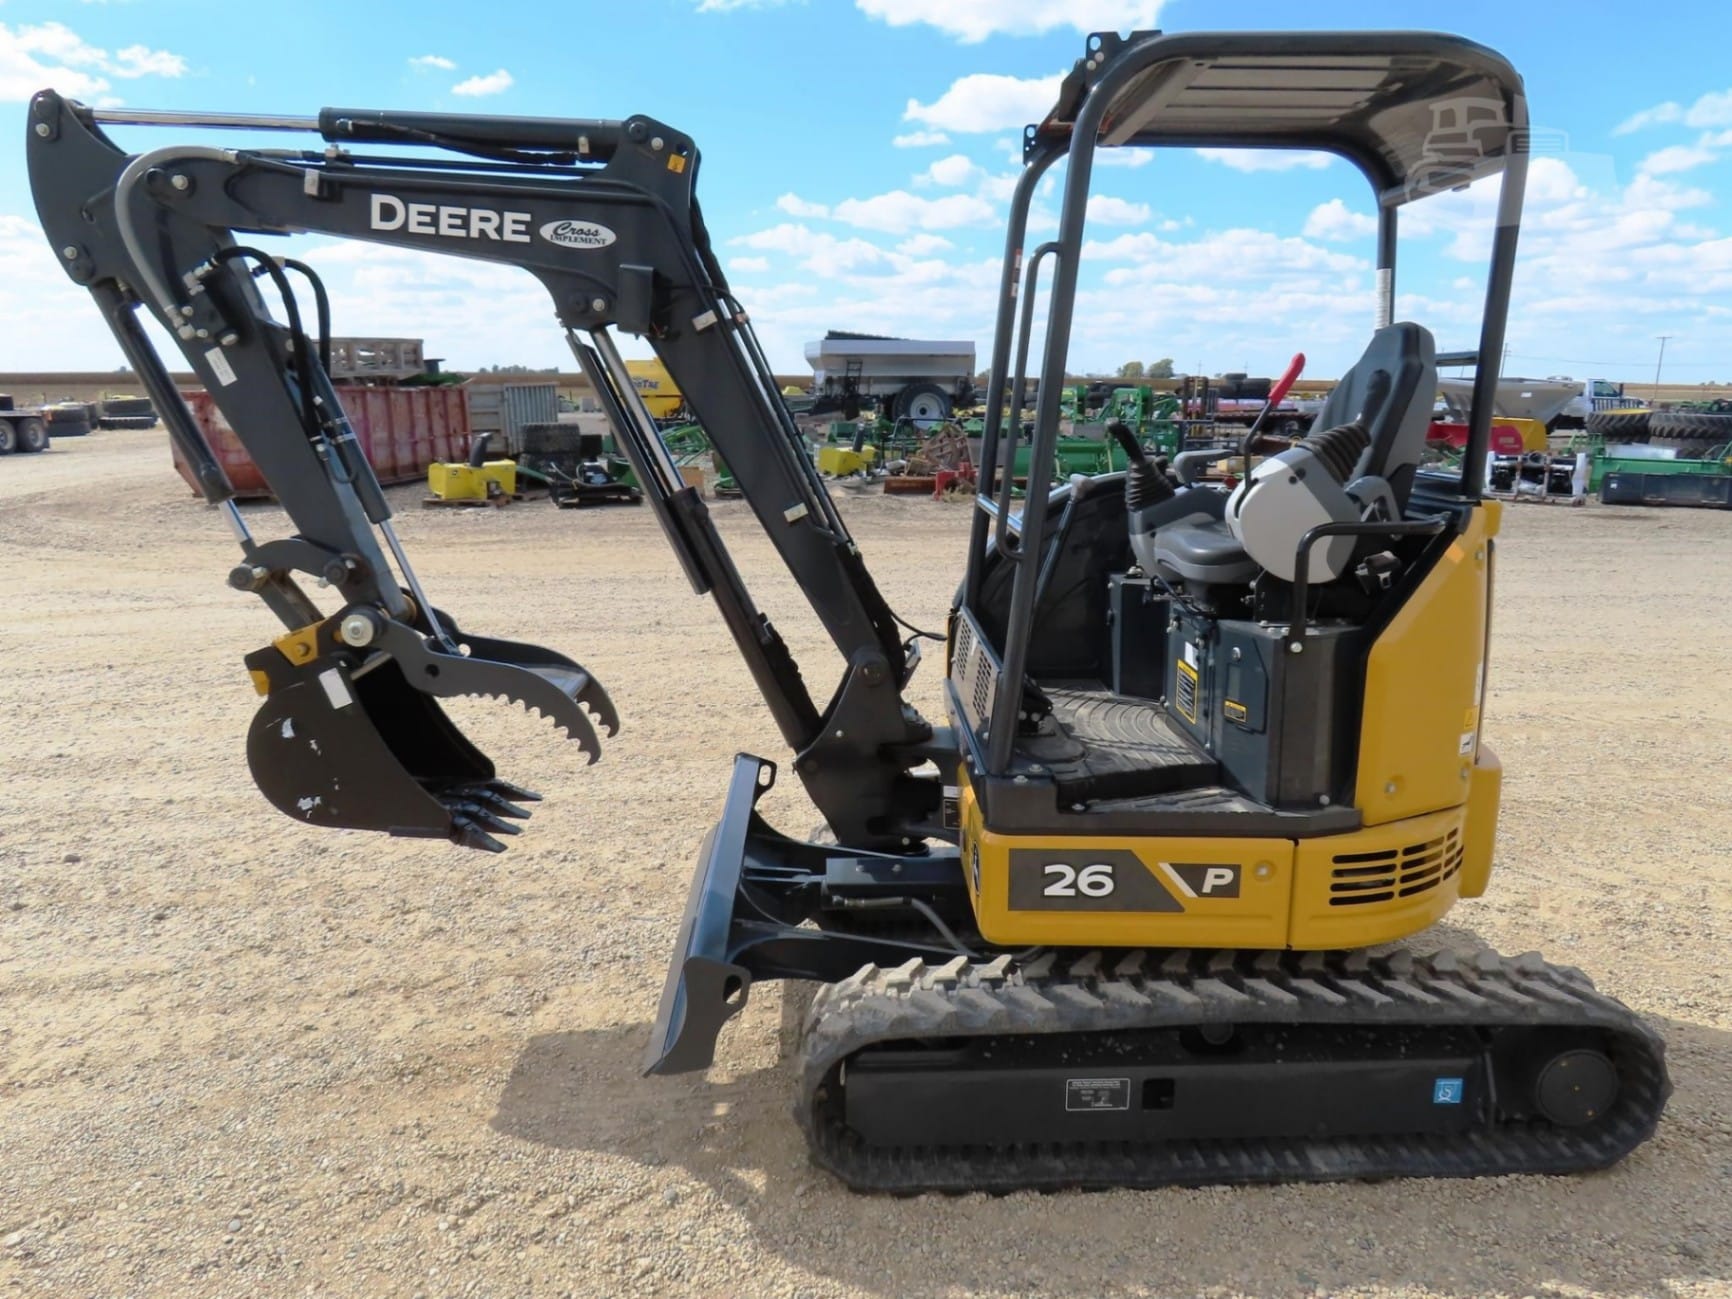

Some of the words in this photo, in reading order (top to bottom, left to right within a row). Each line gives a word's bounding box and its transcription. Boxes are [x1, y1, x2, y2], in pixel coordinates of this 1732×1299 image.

[370, 193, 532, 243] DEERE
[553, 221, 601, 237] Cross
[550, 234, 607, 246] IMPLEMENT
[1043, 864, 1115, 897] 26
